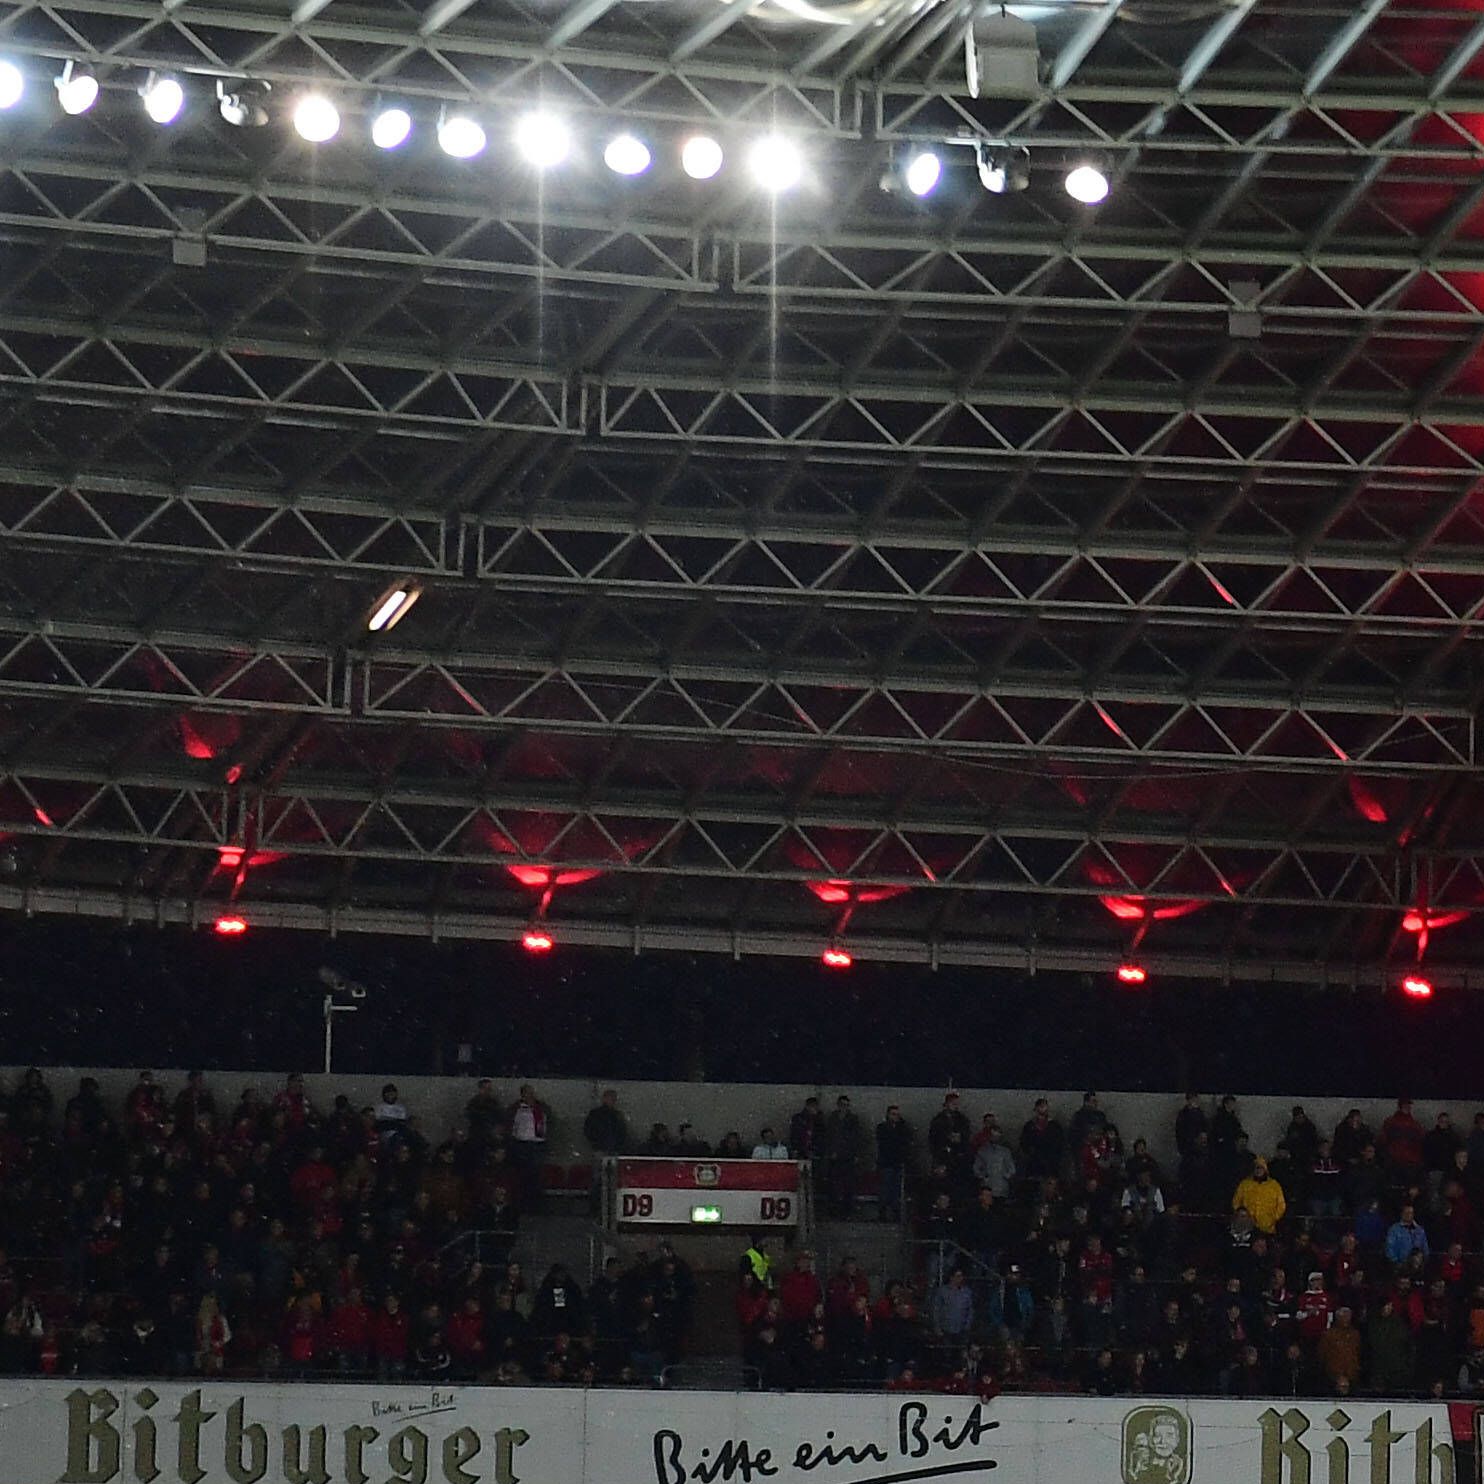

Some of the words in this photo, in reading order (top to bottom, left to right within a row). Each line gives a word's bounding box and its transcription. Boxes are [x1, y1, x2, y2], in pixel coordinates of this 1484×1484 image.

[622, 1193, 653, 1217] D9
[761, 1196, 791, 1220] D9
[793, 1431, 887, 1473] ein
[899, 1400, 1000, 1459] Bit
